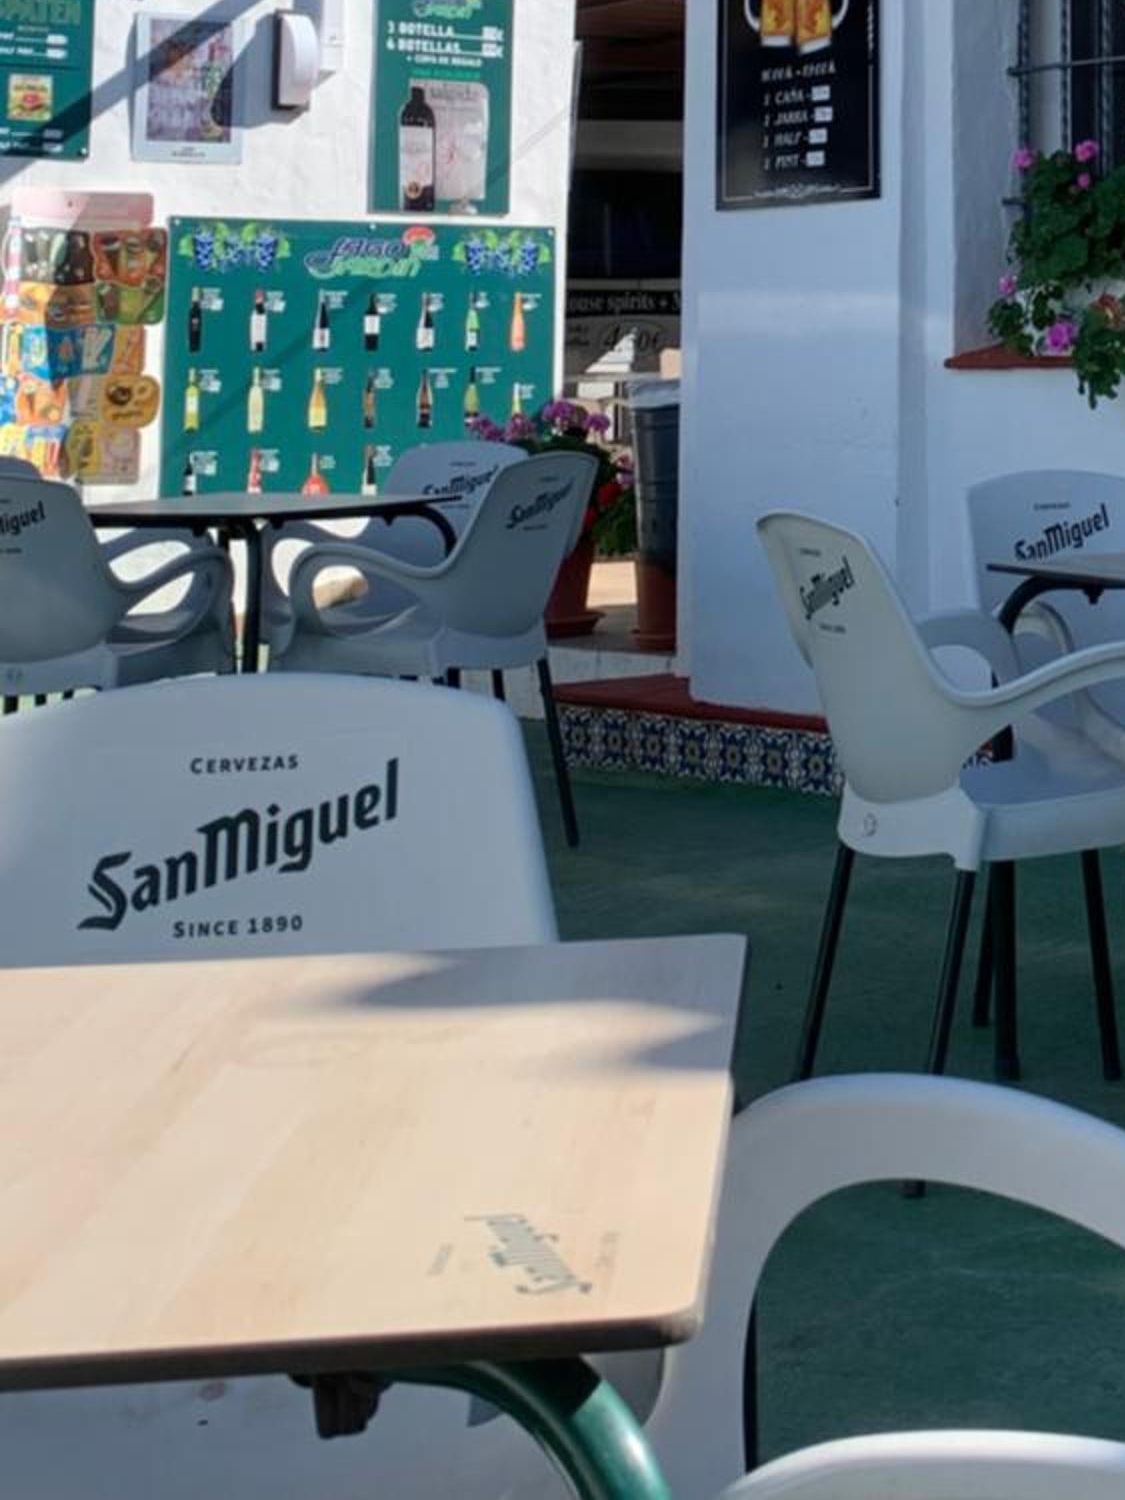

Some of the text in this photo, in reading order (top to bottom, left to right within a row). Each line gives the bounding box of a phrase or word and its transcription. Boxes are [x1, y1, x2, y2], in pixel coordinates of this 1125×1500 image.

[398, 21, 455, 37] BOTELLA
[397, 38, 462, 54] BOTELLAS
[0, 499, 46, 536] iguel
[1014, 502, 1110, 562] SanMiguel
[190, 754, 300, 775] CERVEZAS
[76, 756, 399, 931] SanMiguel
[173, 914, 304, 939] SINCE 1890
